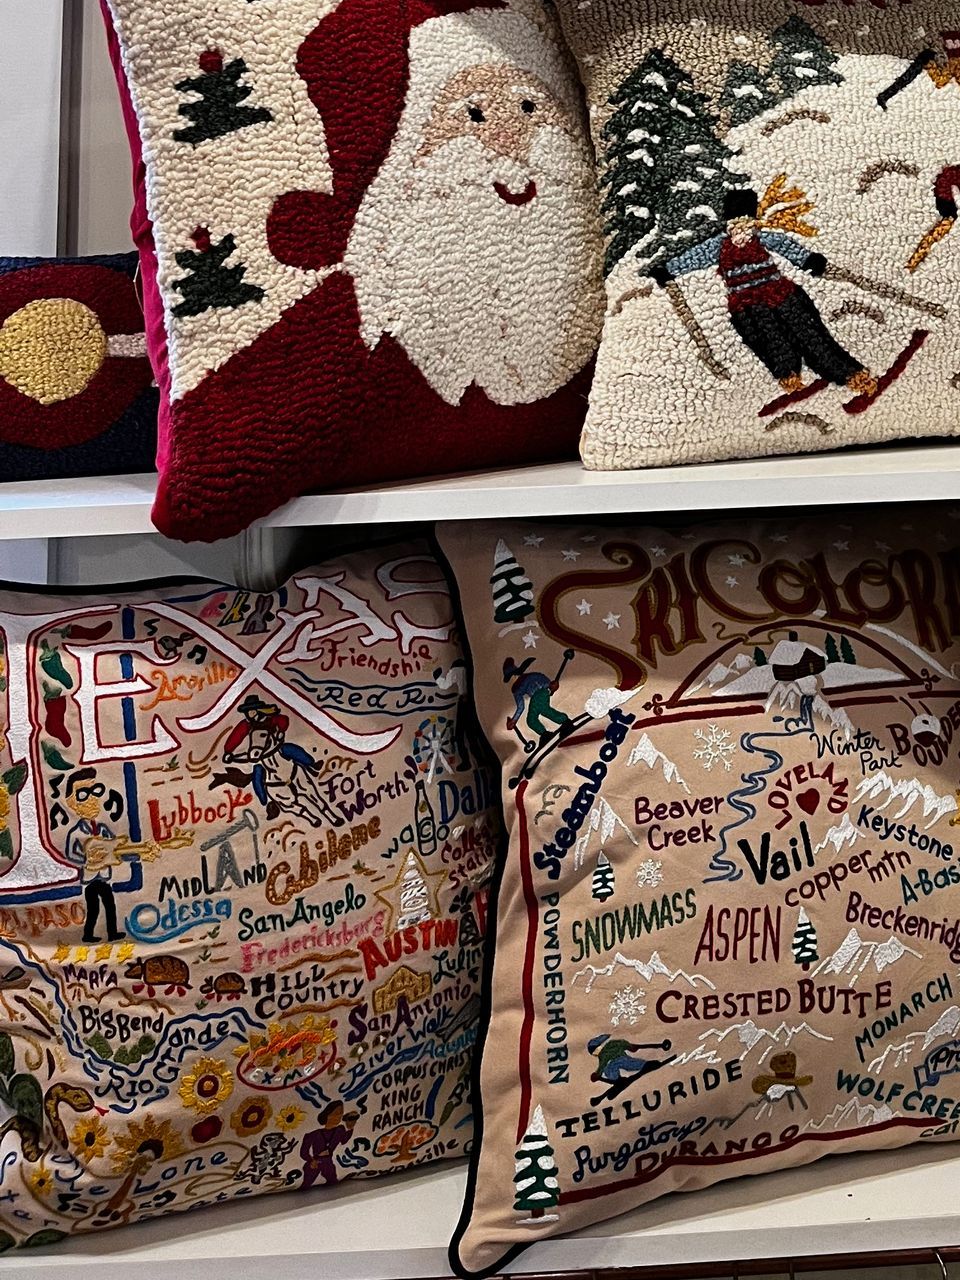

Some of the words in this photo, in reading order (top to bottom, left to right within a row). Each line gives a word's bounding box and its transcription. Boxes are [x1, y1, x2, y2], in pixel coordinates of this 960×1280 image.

[316, 686, 388, 710] Red
[808, 728, 886, 758] Winter
[859, 750, 902, 775] Park
[318, 759, 377, 803] Fort
[533, 708, 636, 880] Steamboat
[767, 762, 850, 831] LOVELAND
[147, 786, 254, 844] Lubbock
[634, 795, 724, 825] Beaver
[647, 819, 716, 851] Creek
[856, 804, 954, 862] Keystone
[737, 820, 815, 886] Vail
[124, 898, 233, 941] Odessa
[237, 907, 286, 942] San
[284, 882, 367, 927] Angelo
[570, 888, 698, 963] SNOWMASS
[694, 904, 782, 966] ASPEN
[62, 962, 119, 991] MARFA
[357, 918, 459, 982] AUSTIN
[254, 976, 364, 1021] Country
[541, 891, 570, 1085] POWDERHORN
[655, 988, 792, 1024] CRESTED
[797, 978, 893, 1018] BUTTE
[855, 973, 953, 1063] MONARCH
[380, 1083, 422, 1112] KING
[555, 1058, 744, 1139] TELLURIDE
[836, 1069, 905, 1104] WOLF
[371, 1099, 425, 1132] RANCH
[572, 1116, 708, 1183] Purgatory
[634, 1124, 801, 1177] DURANGO
